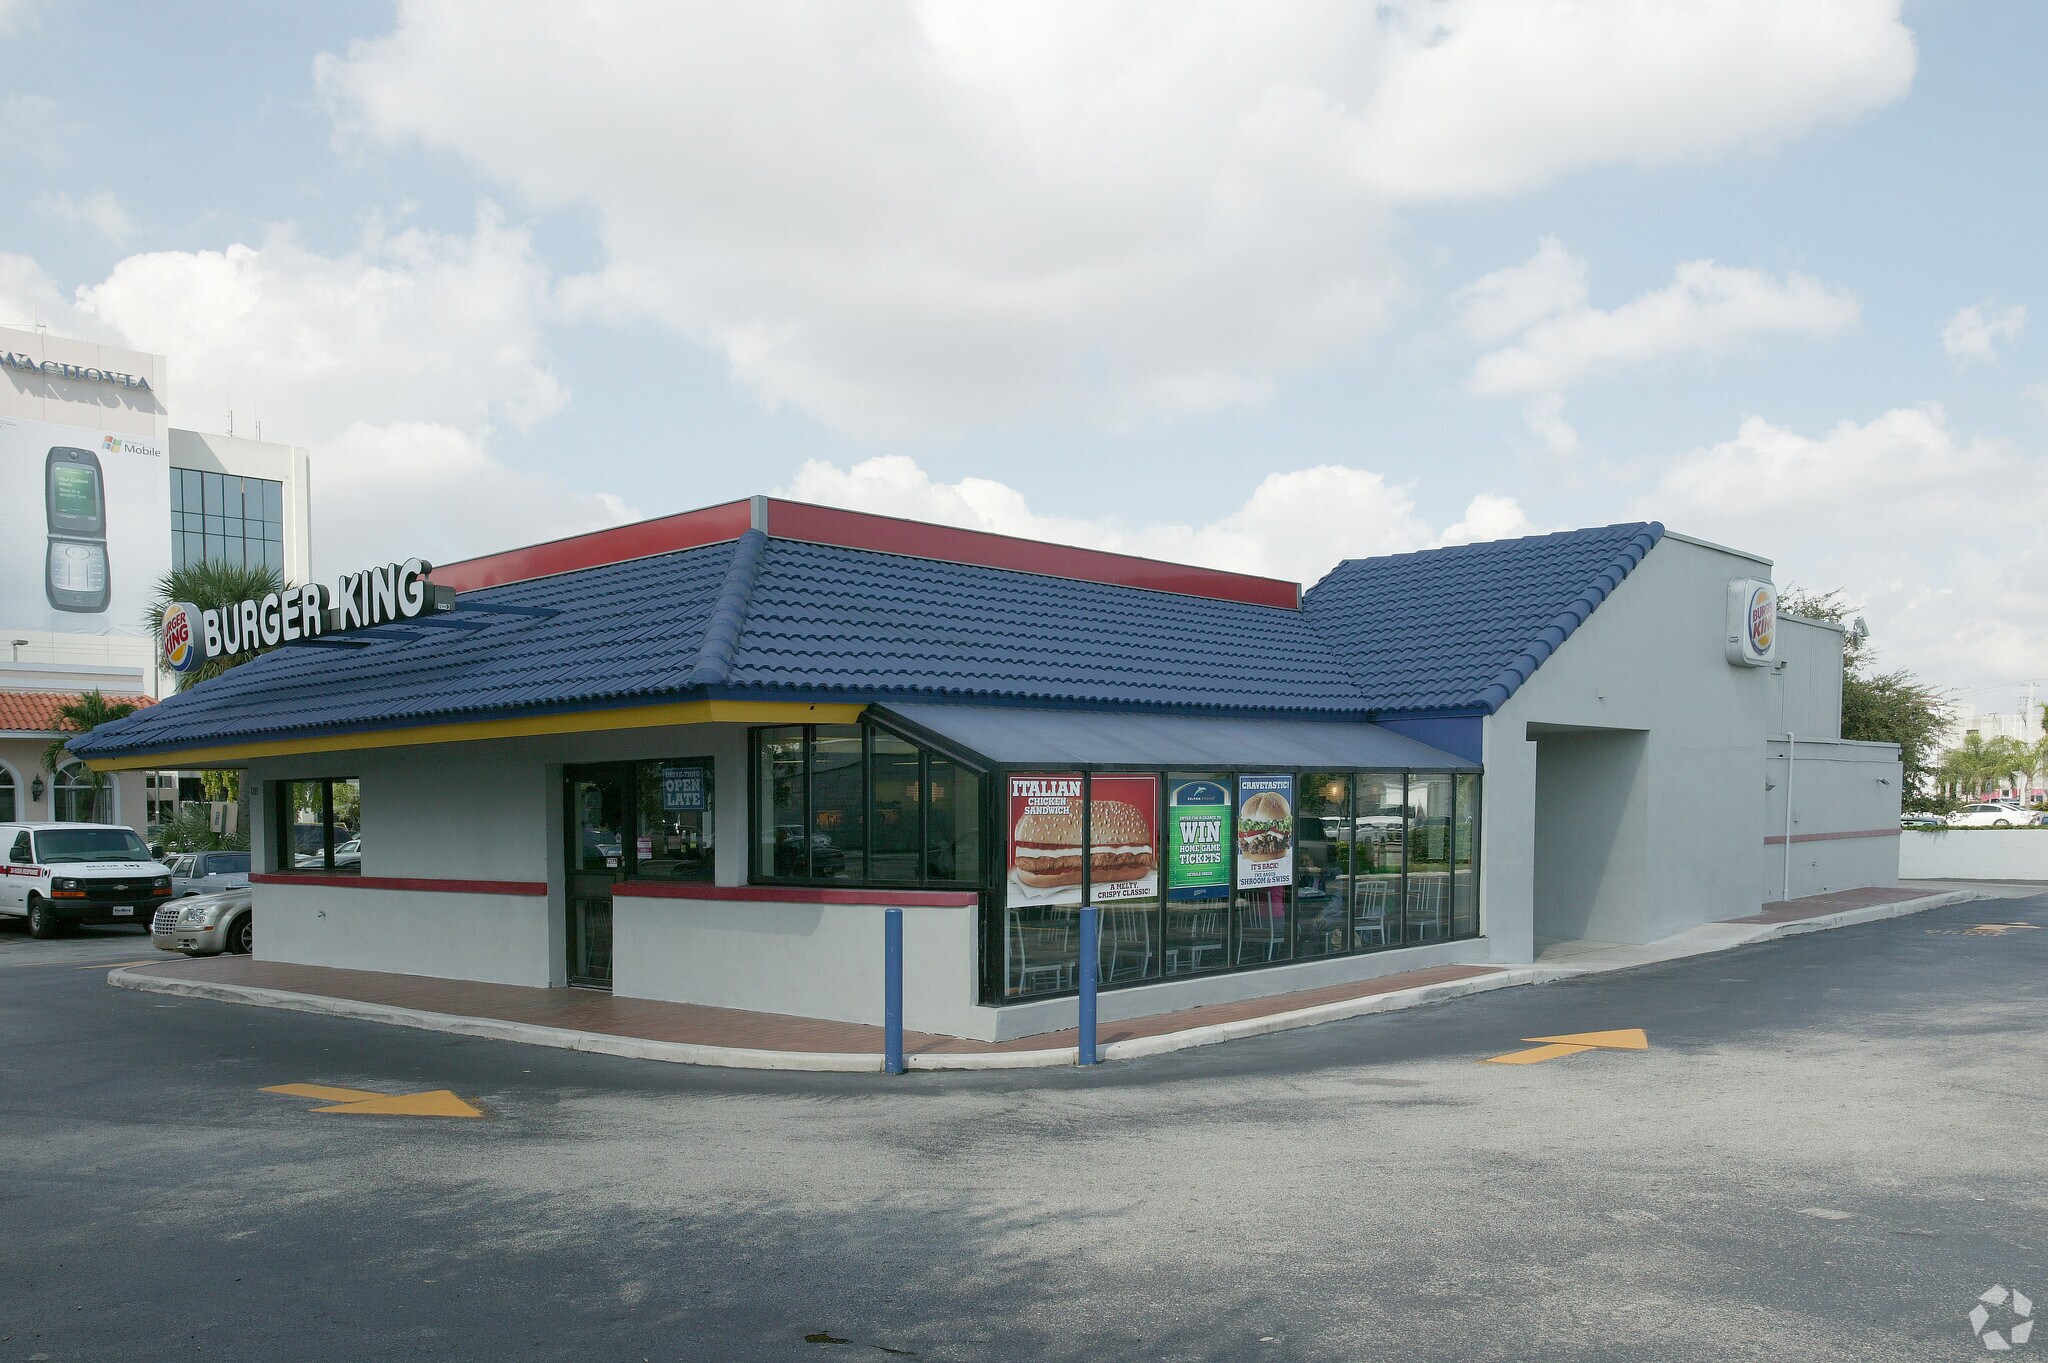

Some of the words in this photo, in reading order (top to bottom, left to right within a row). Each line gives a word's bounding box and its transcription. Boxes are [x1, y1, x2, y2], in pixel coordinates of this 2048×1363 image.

[0, 351, 154, 391] WACHOVIA
[124, 444, 161, 457] Mobile
[202, 583, 322, 658] BURGER
[339, 556, 424, 631] KING
[165, 623, 189, 656] KING
[665, 778, 701, 792] OPEN
[1012, 780, 1081, 797] ITALIAN
[1241, 781, 1290, 790] CRAVETASTIC!
[667, 792, 701, 806] LATE
[1028, 797, 1067, 806] CHICKEN
[1024, 806, 1070, 815] SANDWICH
[1179, 821, 1221, 844] WIN
[1179, 844, 1200, 853] HOME
[1201, 843, 1221, 852] GAME
[1179, 852, 1221, 865] TICKETS
[1251, 863, 1262, 871] IT'S
[1262, 862, 1279, 870] BACK!
[1267, 876, 1272, 884] &
[1272, 875, 1290, 883] SWISS
[1097, 890, 1121, 899] CRISPY
[1122, 887, 1151, 897] CLASSIC!
